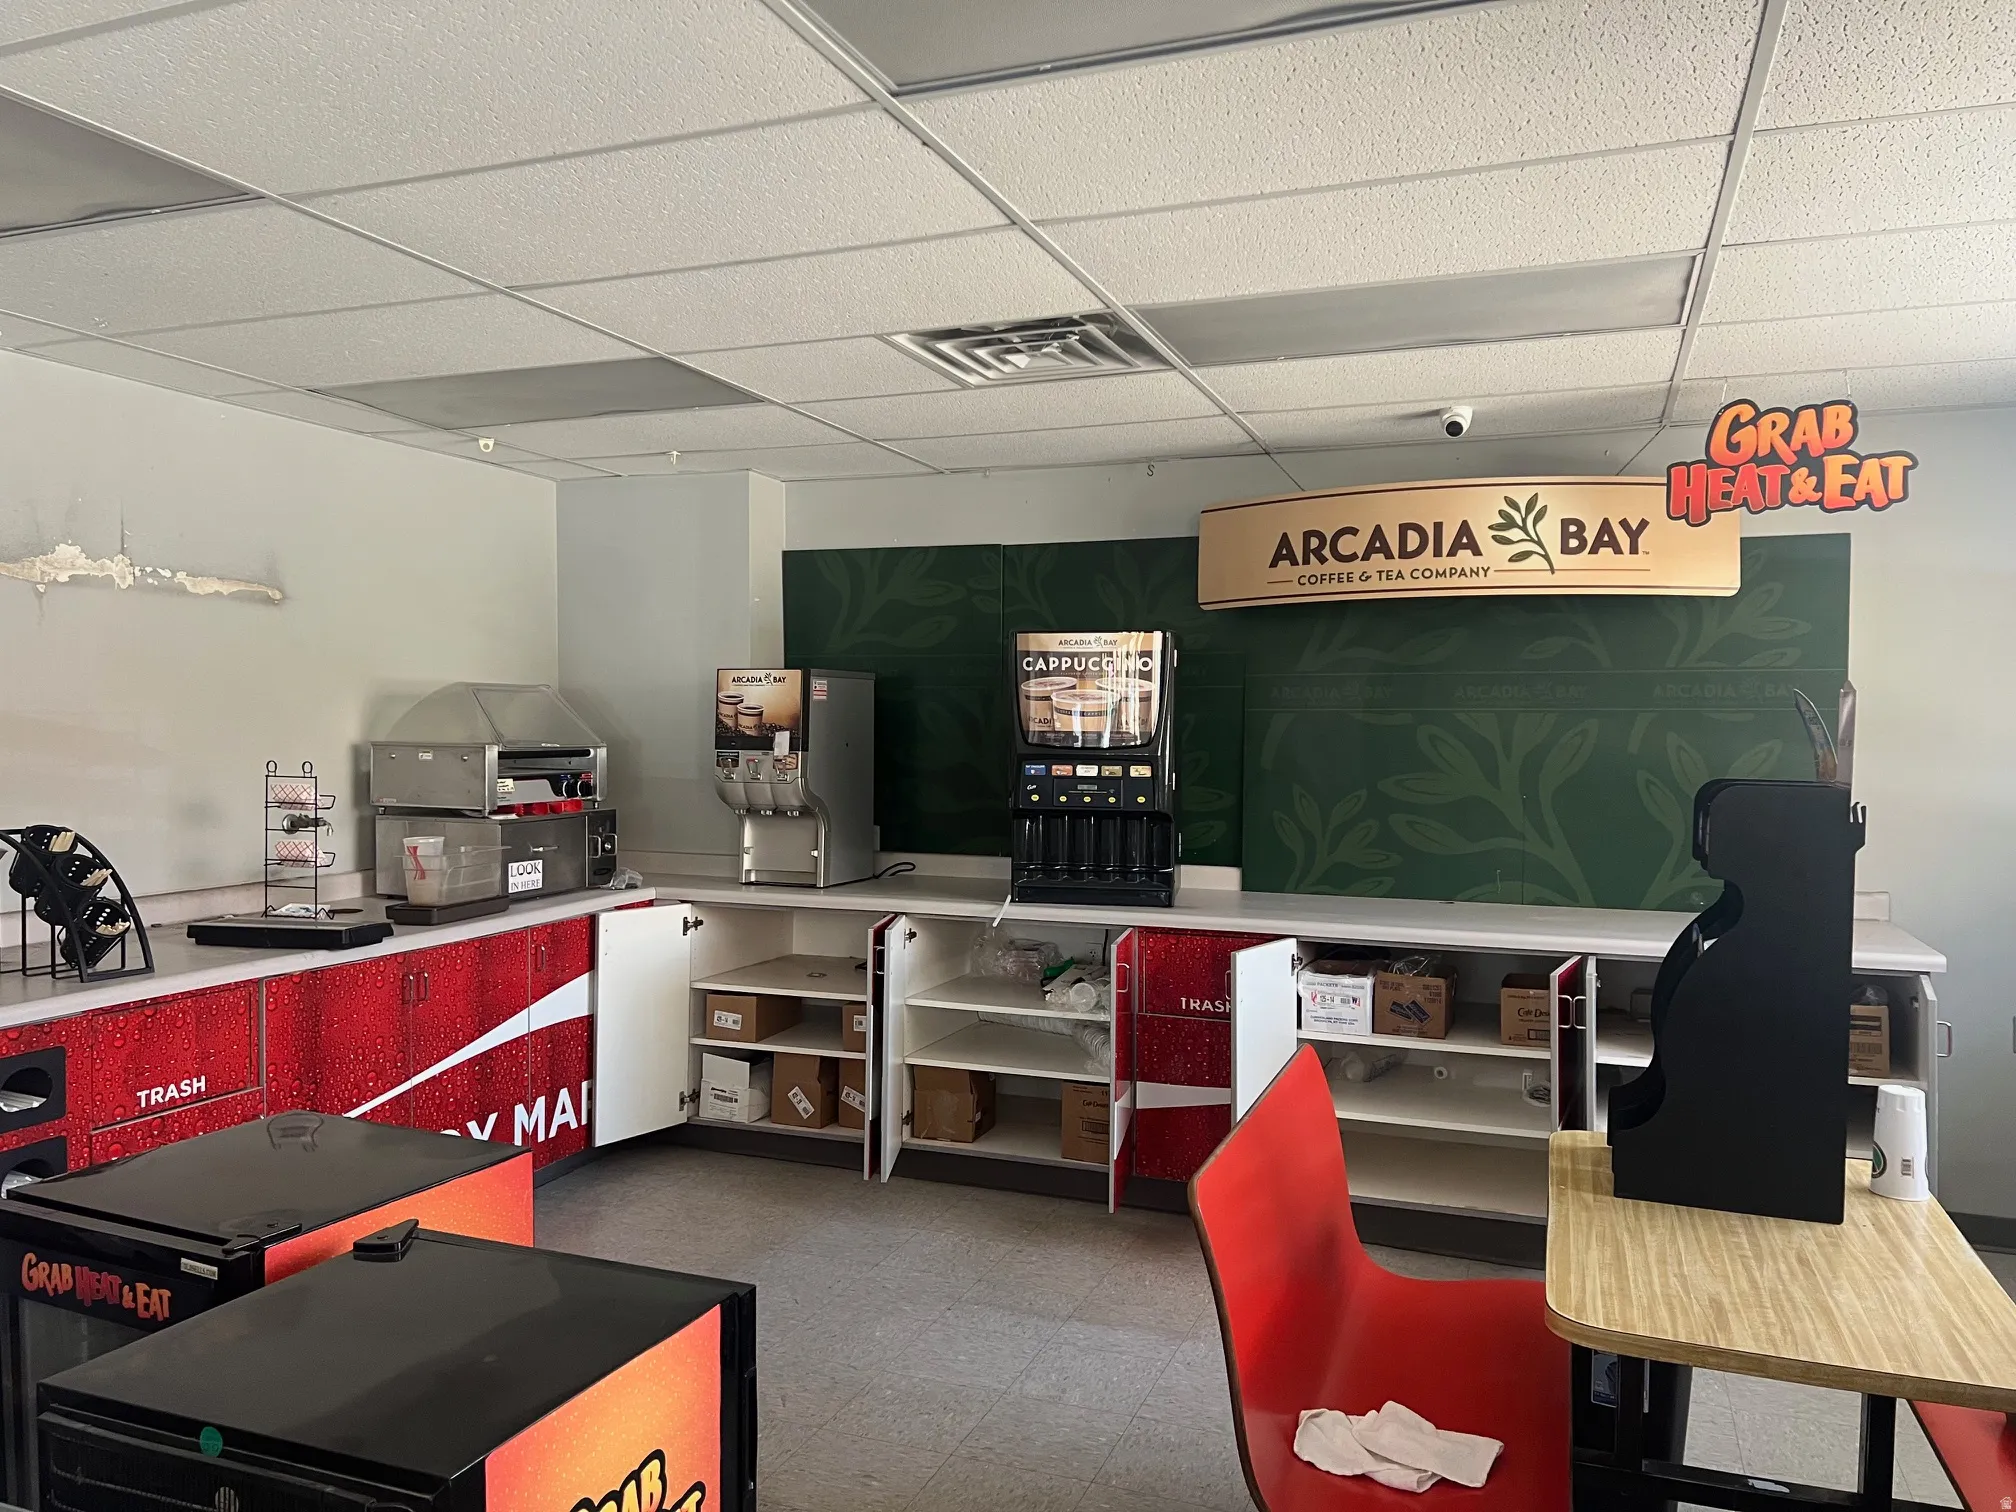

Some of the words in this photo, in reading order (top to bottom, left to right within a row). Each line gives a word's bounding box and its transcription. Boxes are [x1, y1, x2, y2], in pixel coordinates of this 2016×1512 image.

[1709, 403, 1854, 466] GRAB
[1669, 462, 1791, 524] HEAT
[1788, 466, 1823, 504] &
[1822, 453, 1913, 509] EAT
[1268, 518, 1483, 569] ARCADIA
[1297, 572, 1354, 586] COFFEE
[1358, 571, 1373, 582] &
[1377, 568, 1405, 581] TEA
[1410, 565, 1491, 580] COMPANY
[1058, 639, 1093, 647] ARCADIA
[1022, 656, 1153, 672] CAPPUCCINO
[510, 862, 542, 878] LOOK
[510, 880, 520, 892] IN
[520, 878, 541, 890] HERE
[136, 1075, 206, 1108] TRASH
[21, 1252, 73, 1297] GRAB
[74, 1265, 123, 1307] HEAT
[122, 1284, 136, 1309] &
[135, 1282, 172, 1322] EAT
